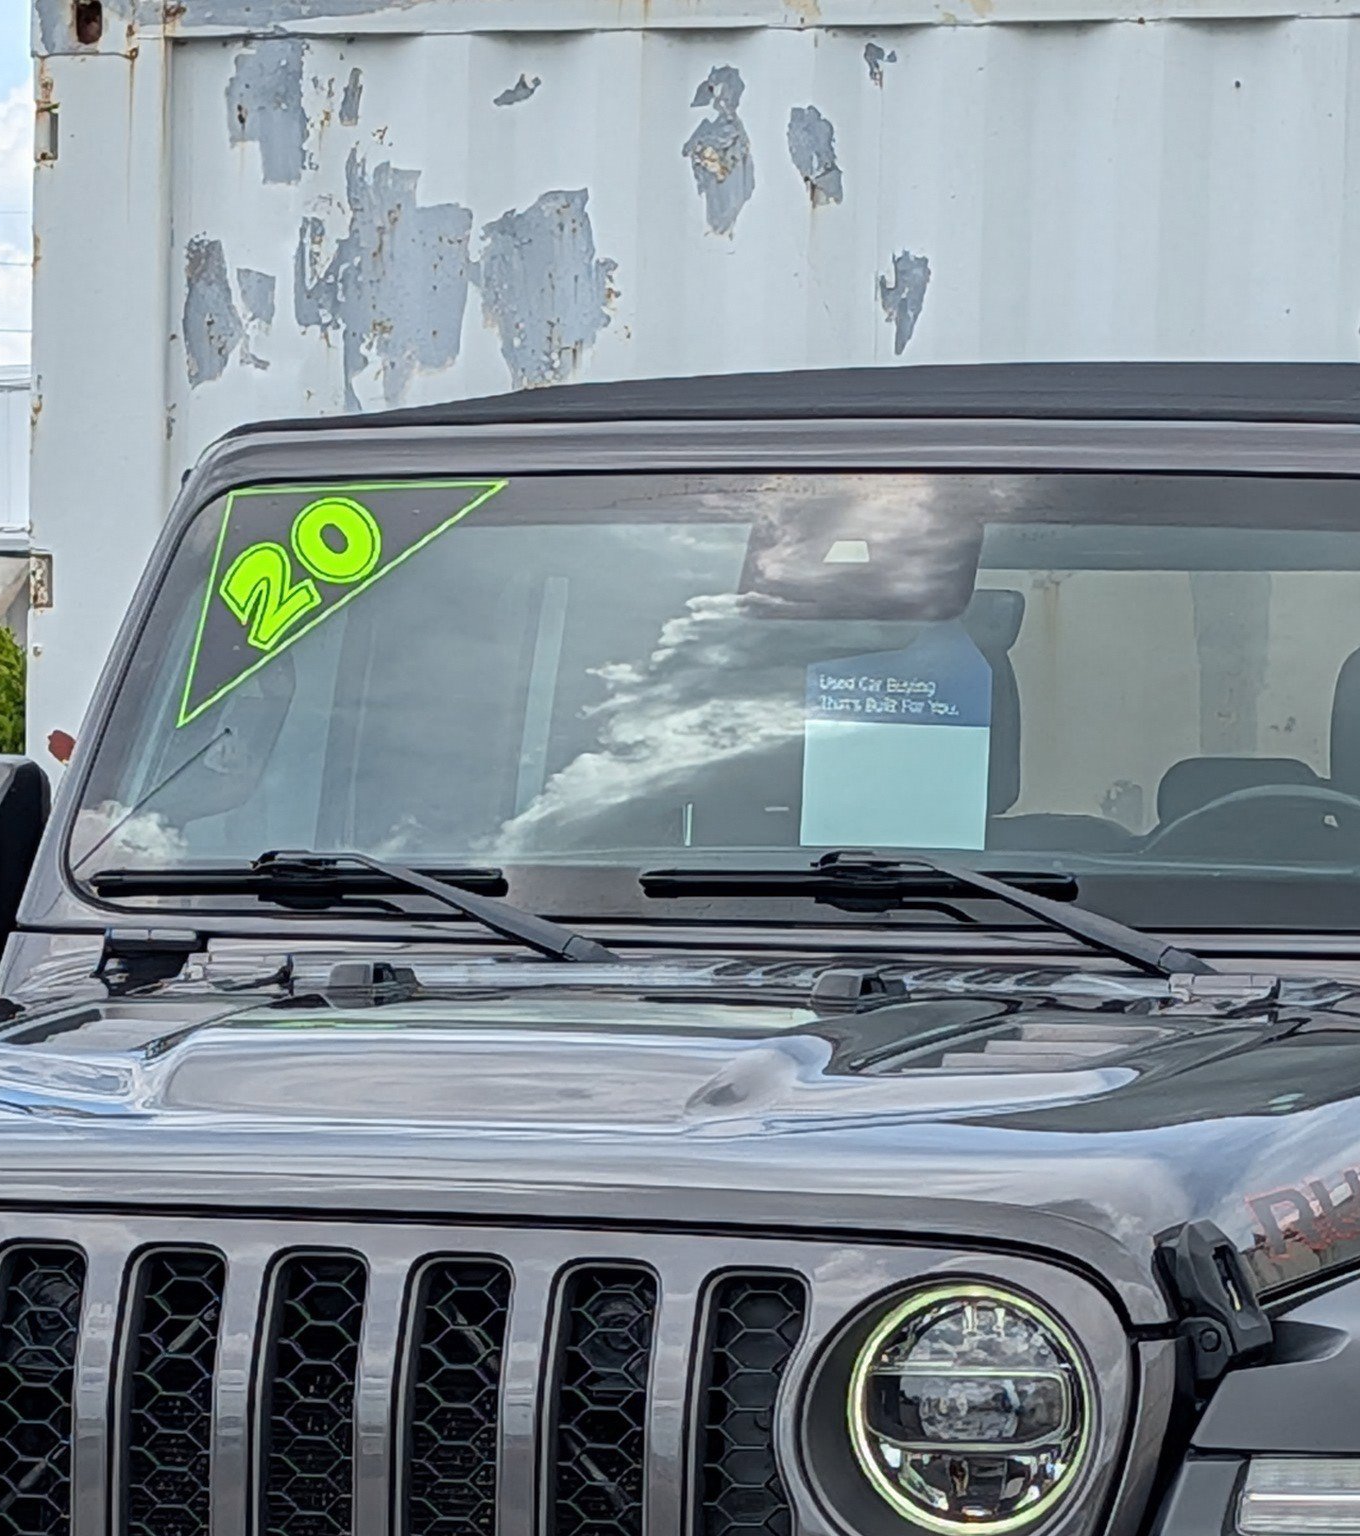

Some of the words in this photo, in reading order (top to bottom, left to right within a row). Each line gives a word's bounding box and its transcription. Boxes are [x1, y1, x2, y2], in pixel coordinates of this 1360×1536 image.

[219, 496, 382, 651] 20
[819, 674, 855, 690] Used
[858, 677, 882, 692] Car
[886, 677, 936, 698] Buying
[901, 699, 925, 714] For
